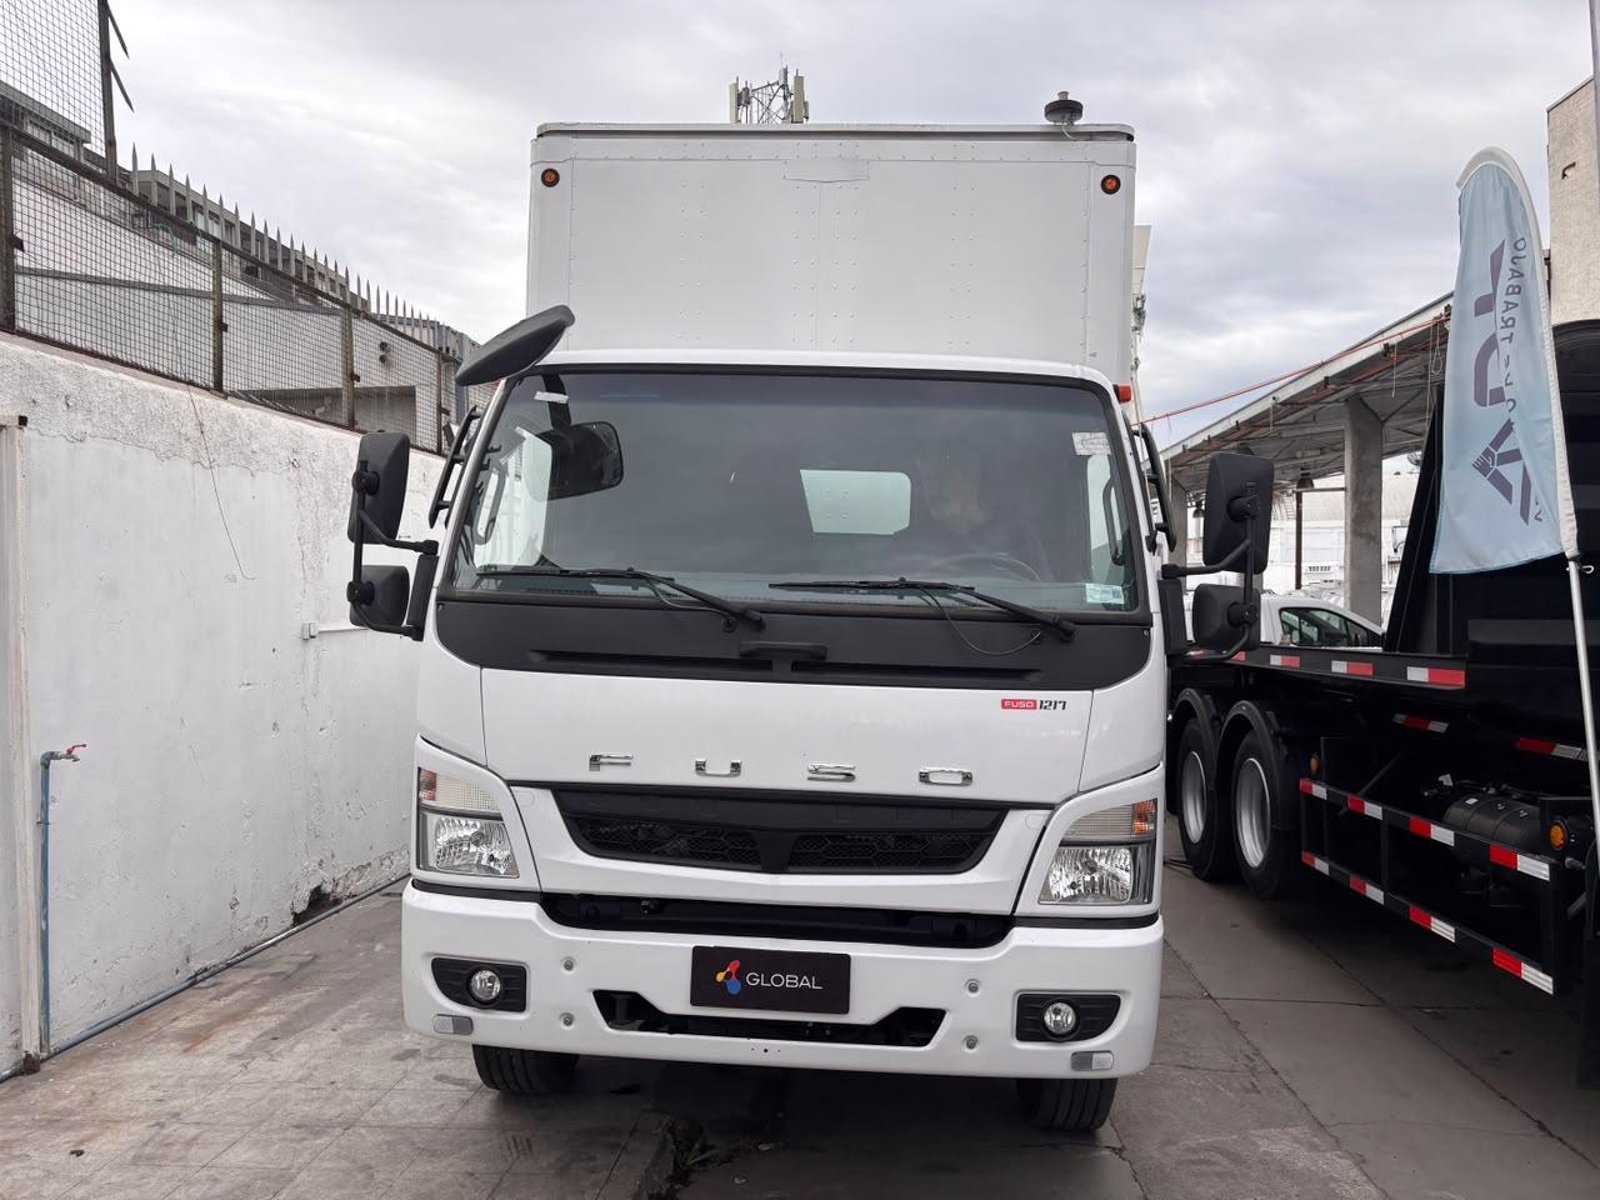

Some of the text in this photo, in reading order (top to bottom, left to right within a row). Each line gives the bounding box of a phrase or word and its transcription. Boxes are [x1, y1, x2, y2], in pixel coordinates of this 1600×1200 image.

[1003, 699, 1067, 710] FUSO 1217
[588, 753, 973, 786] FUSO
[745, 971, 823, 990] GLOBAL
